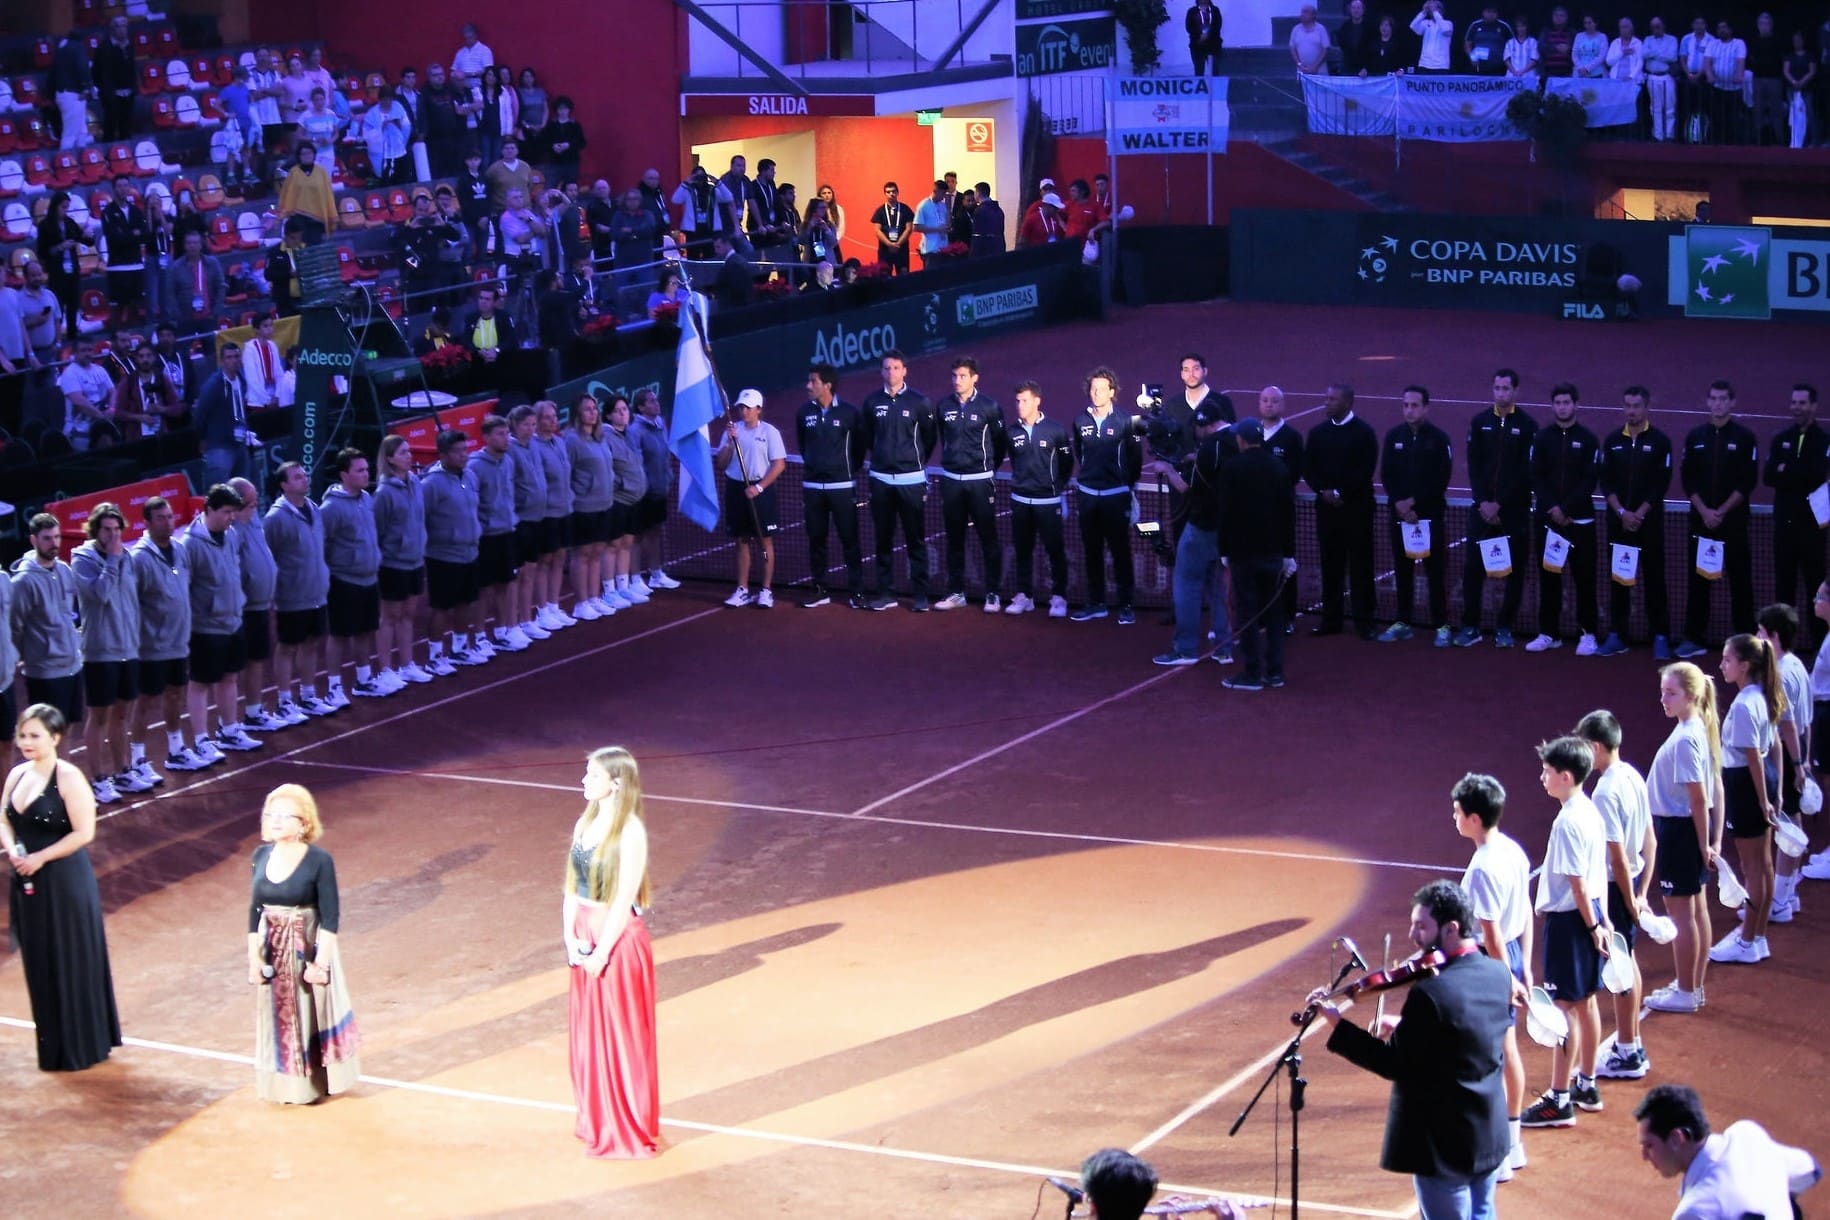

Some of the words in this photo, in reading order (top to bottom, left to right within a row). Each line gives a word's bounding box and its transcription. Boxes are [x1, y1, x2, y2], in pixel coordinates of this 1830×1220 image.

[1018, 53, 1035, 74] an
[1040, 41, 1067, 71] ITF
[1120, 79, 1209, 96] MONICA
[1406, 80, 1445, 93] PUNTO
[749, 96, 808, 115] SALIDA
[1122, 132, 1209, 149] WALTER
[1410, 239, 1488, 261] COPA
[1496, 242, 1577, 264] DAVIS
[1427, 268, 1474, 284] BNP
[1479, 270, 1576, 287] PARIBAS
[1787, 251, 1830, 300] B
[976, 297, 995, 316] BNP
[997, 288, 1034, 311] PARIBAS
[1563, 303, 1606, 320] FILA
[810, 322, 896, 367] Adecco
[298, 348, 352, 366] Adecco
[302, 401, 316, 485] cco.com
